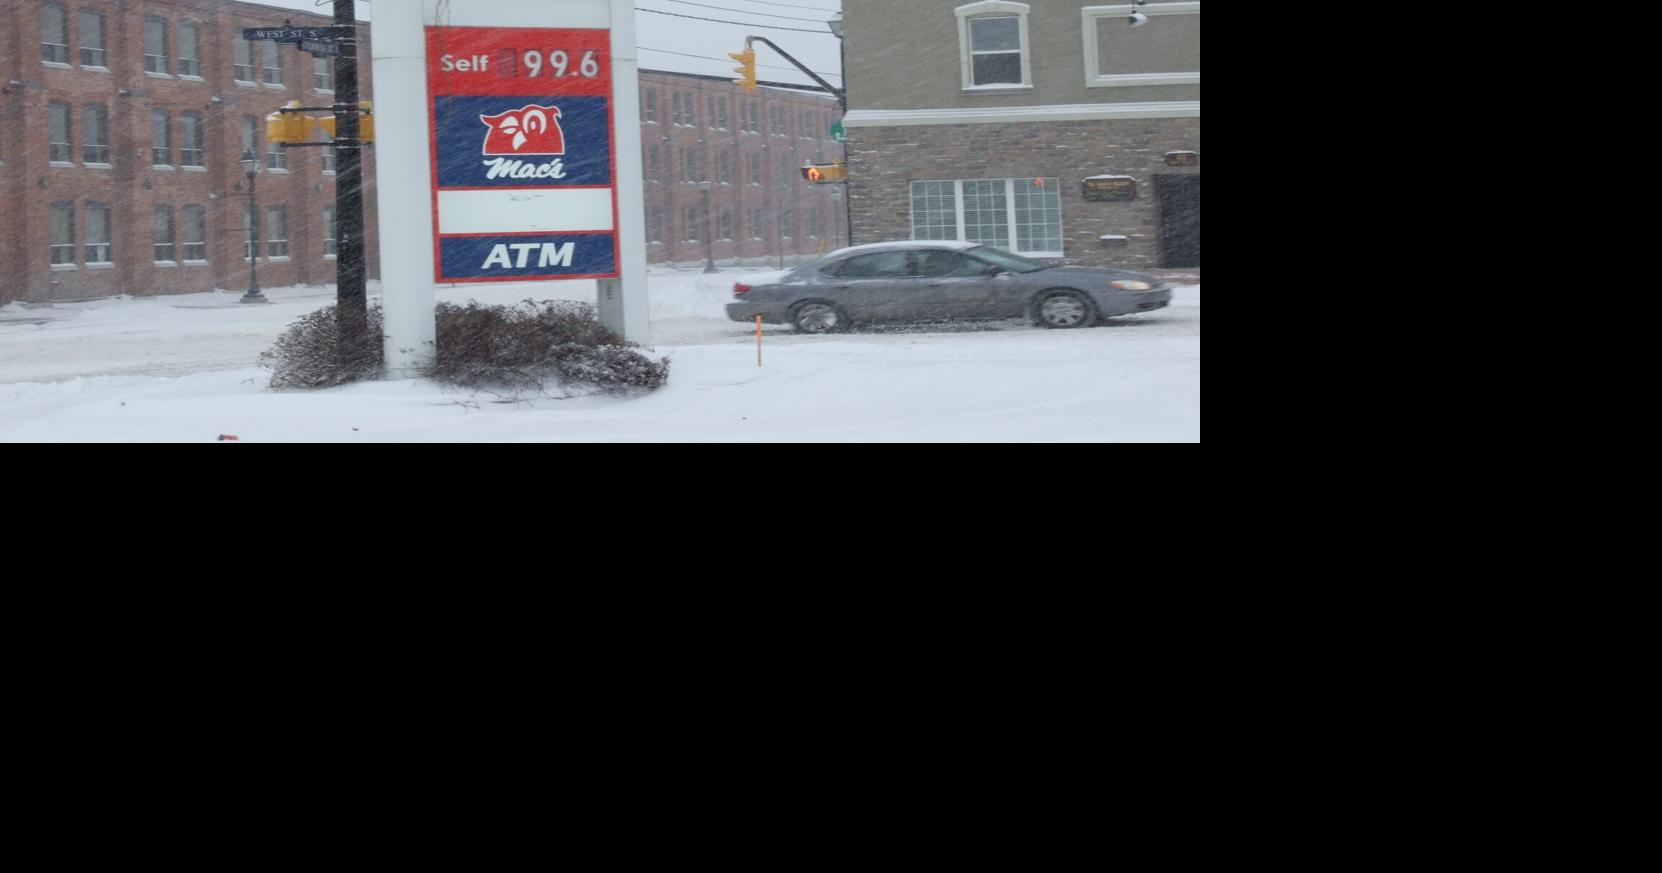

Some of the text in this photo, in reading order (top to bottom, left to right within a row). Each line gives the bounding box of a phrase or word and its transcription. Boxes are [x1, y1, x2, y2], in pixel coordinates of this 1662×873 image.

[255, 30, 284, 38] WEST
[440, 50, 599, 77] Self 99.6
[483, 158, 566, 179] Mac's
[481, 242, 575, 269] ATM
